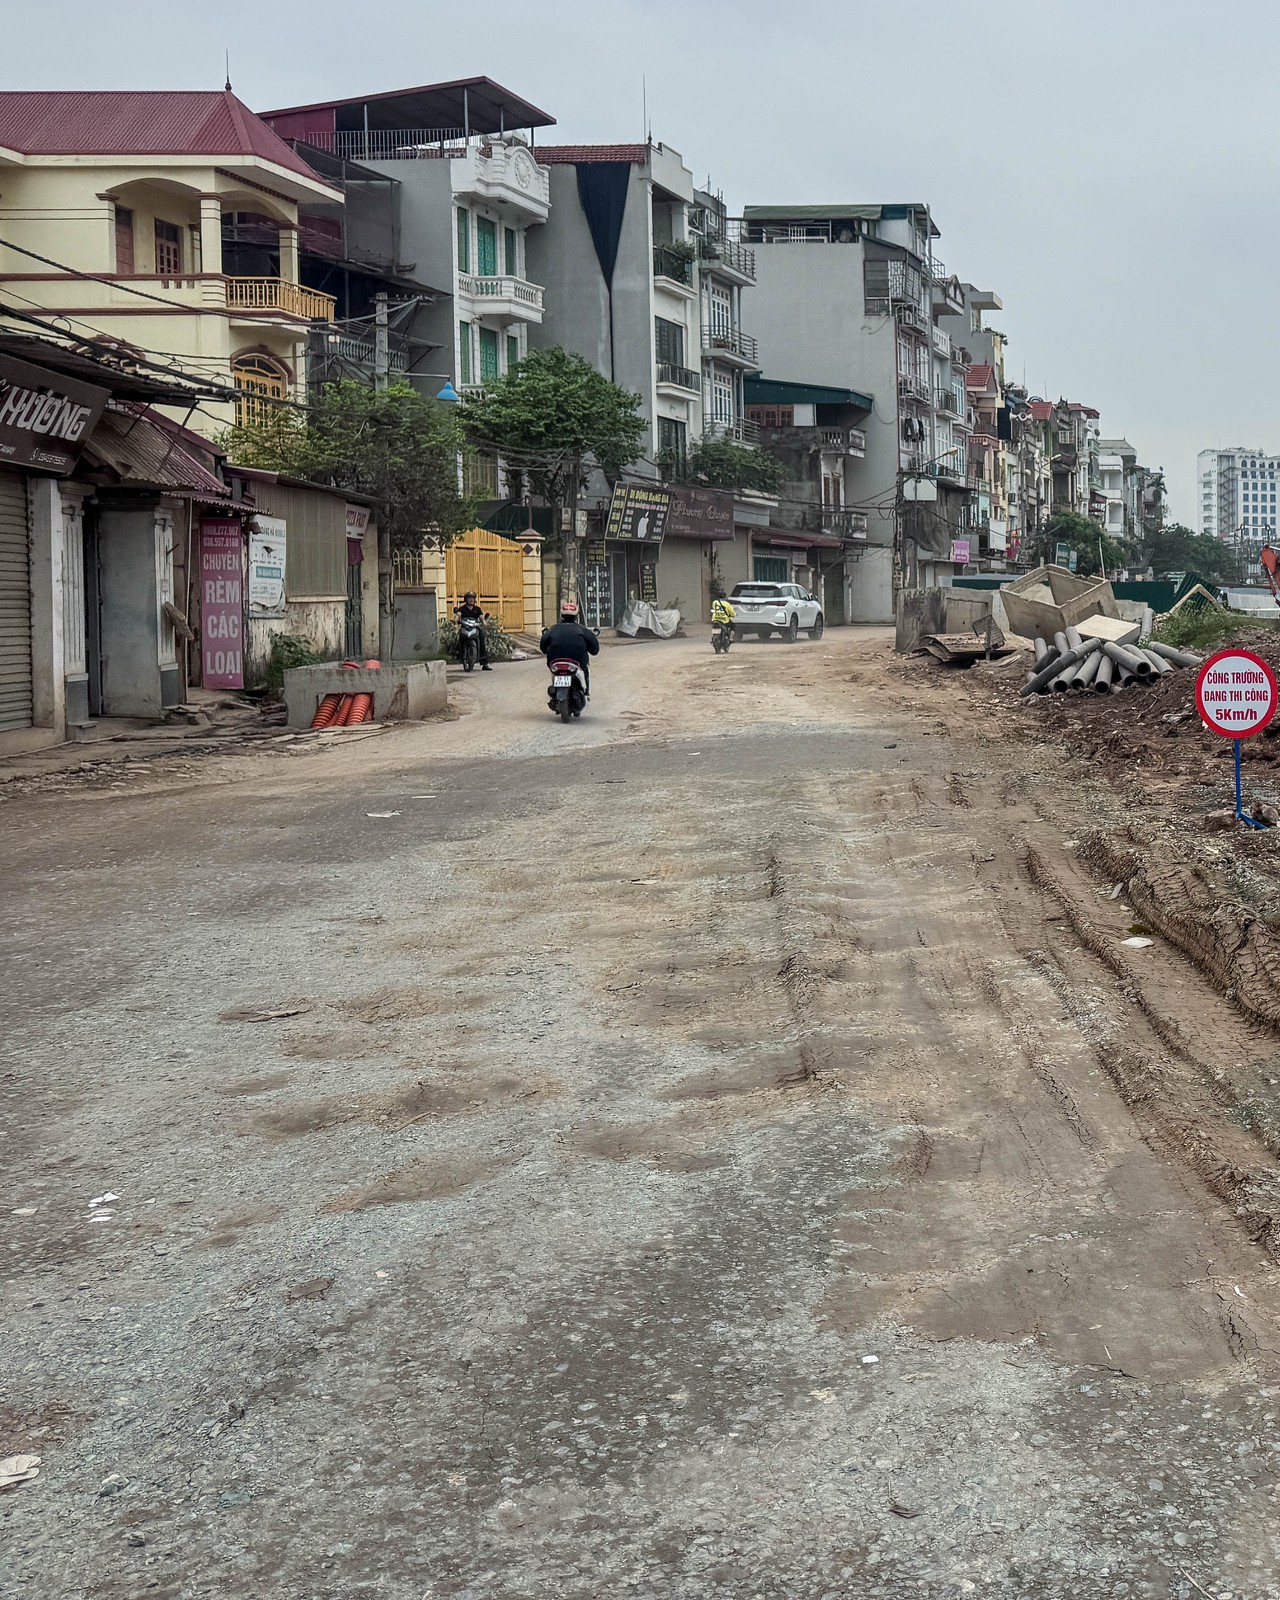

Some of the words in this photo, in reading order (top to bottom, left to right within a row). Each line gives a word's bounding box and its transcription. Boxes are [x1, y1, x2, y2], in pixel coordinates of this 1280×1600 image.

[203, 550, 239, 571] CHUYÊN
[206, 575, 240, 604] RÈM
[207, 610, 239, 639] CÁC
[206, 651, 241, 680] LOẠI
[1207, 670, 1229, 684] CÔNG
[1231, 668, 1264, 684] TRƯỜNG
[1204, 690, 1227, 702] ĐANG
[1229, 690, 1242, 702] THI
[1245, 687, 1268, 702] CÔNG
[1215, 708, 1258, 721] 5Km/h
